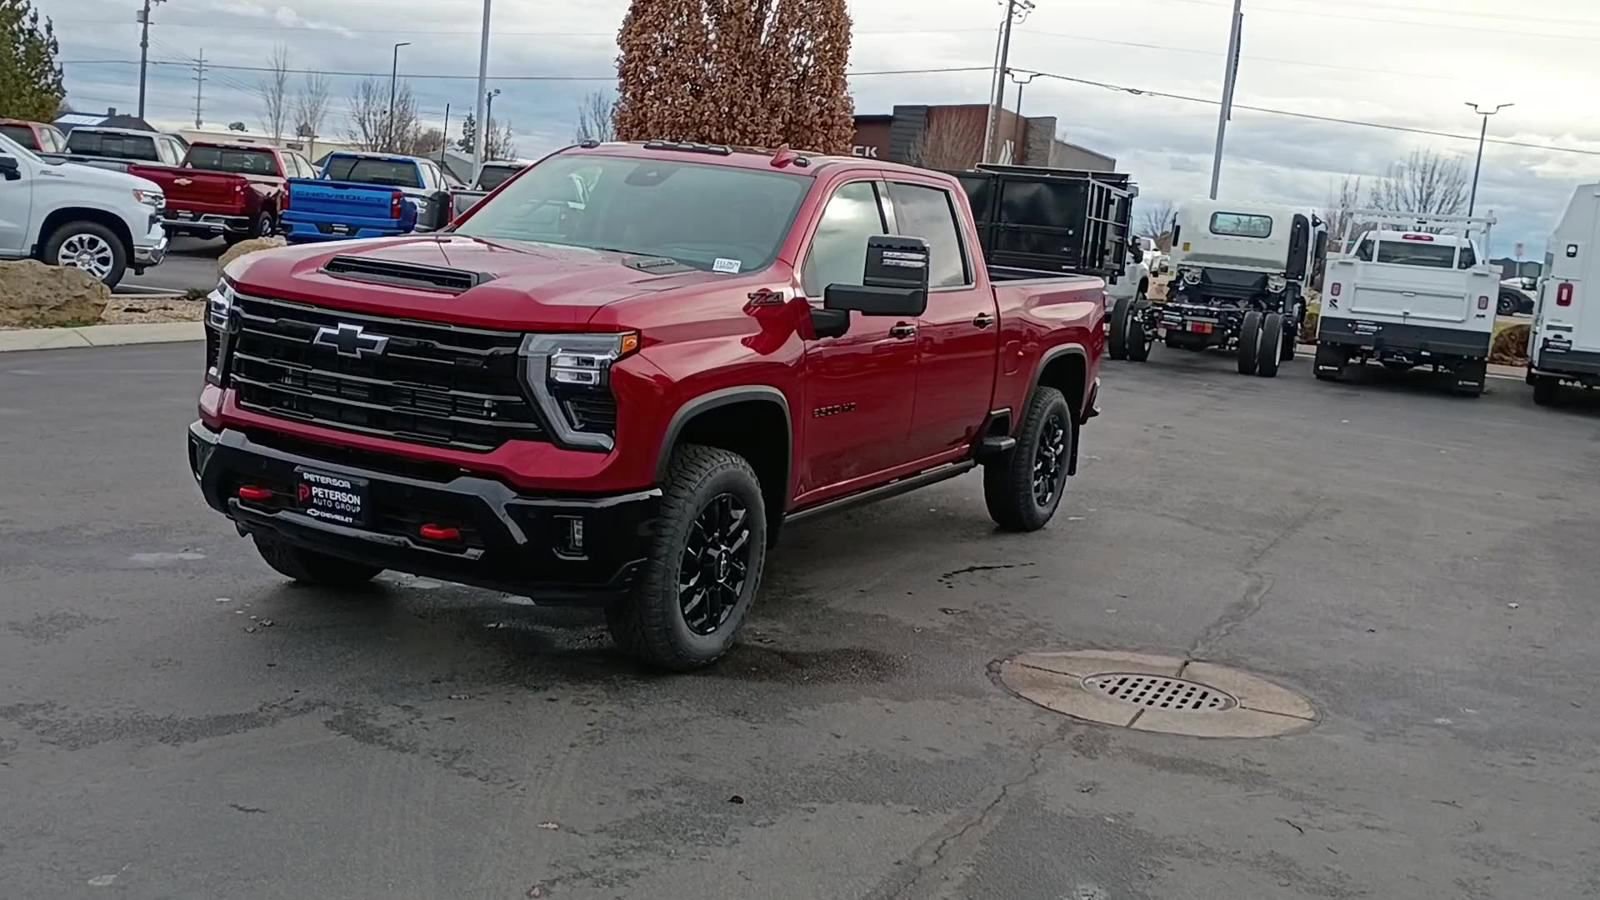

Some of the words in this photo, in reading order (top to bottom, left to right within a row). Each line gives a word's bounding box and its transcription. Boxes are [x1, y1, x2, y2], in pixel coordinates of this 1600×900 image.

[295, 190, 386, 203] CHEVROLET
[311, 486, 361, 506] PETERSON
[313, 497, 333, 508] AUTO
[334, 501, 361, 513] GROUP
